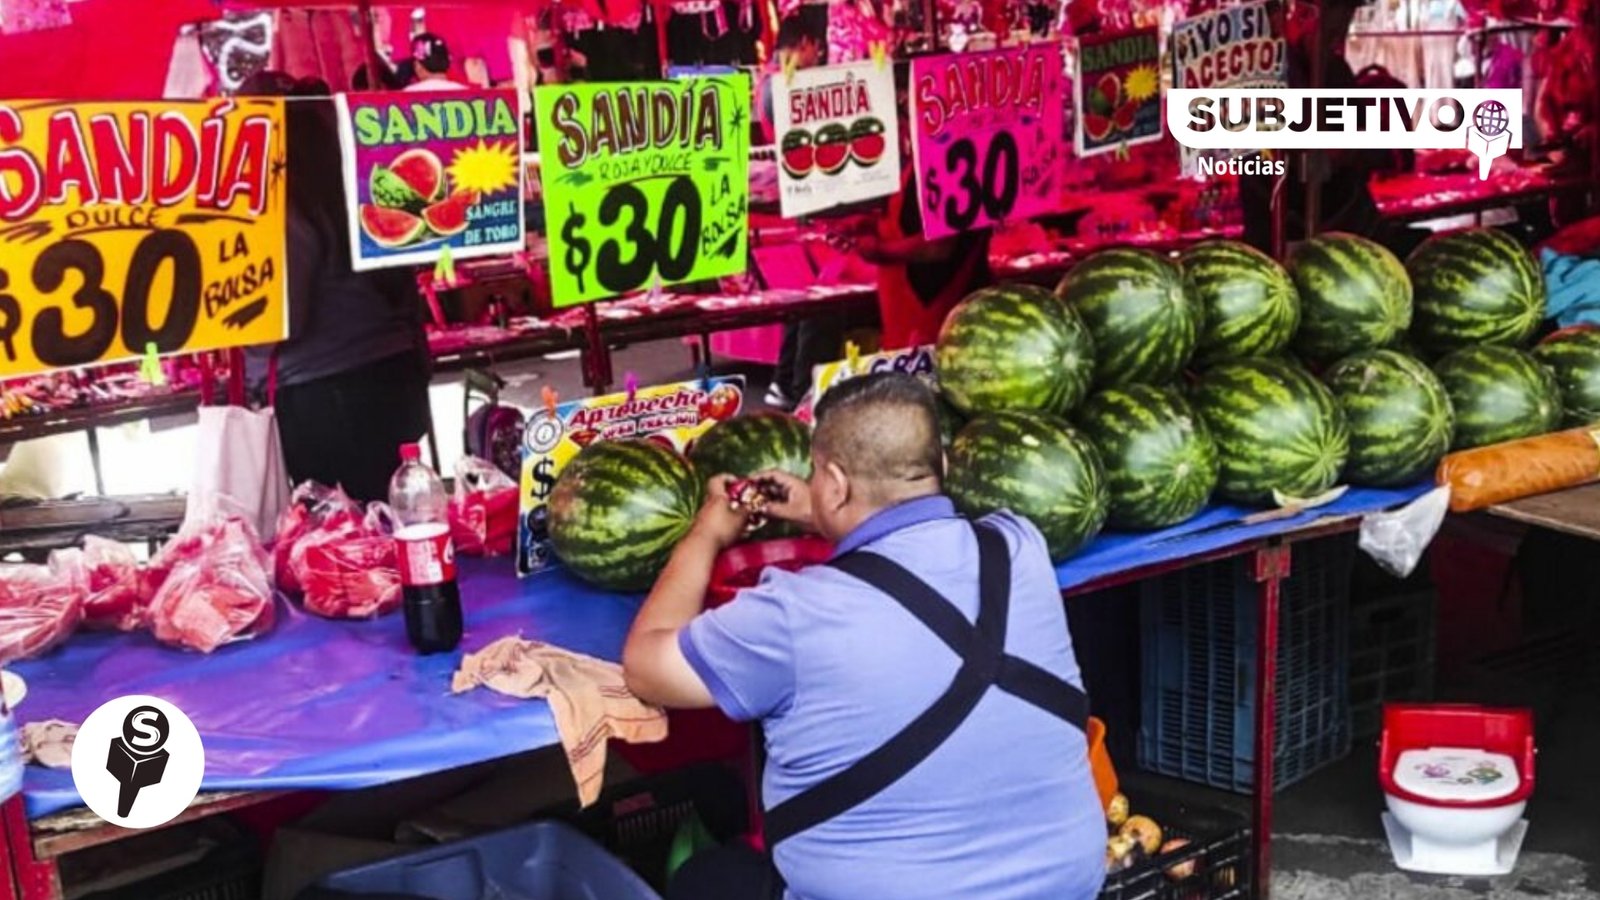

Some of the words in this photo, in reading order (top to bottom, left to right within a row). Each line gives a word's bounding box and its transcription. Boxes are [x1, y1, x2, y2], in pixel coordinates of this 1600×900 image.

[354, 97, 517, 146] SANDIA
[551, 78, 722, 169] SANDÍA
[66, 206, 162, 229] DULCE
[464, 229, 482, 245] DE
[218, 232, 248, 263] LA
[204, 256, 274, 319] BOLSA
